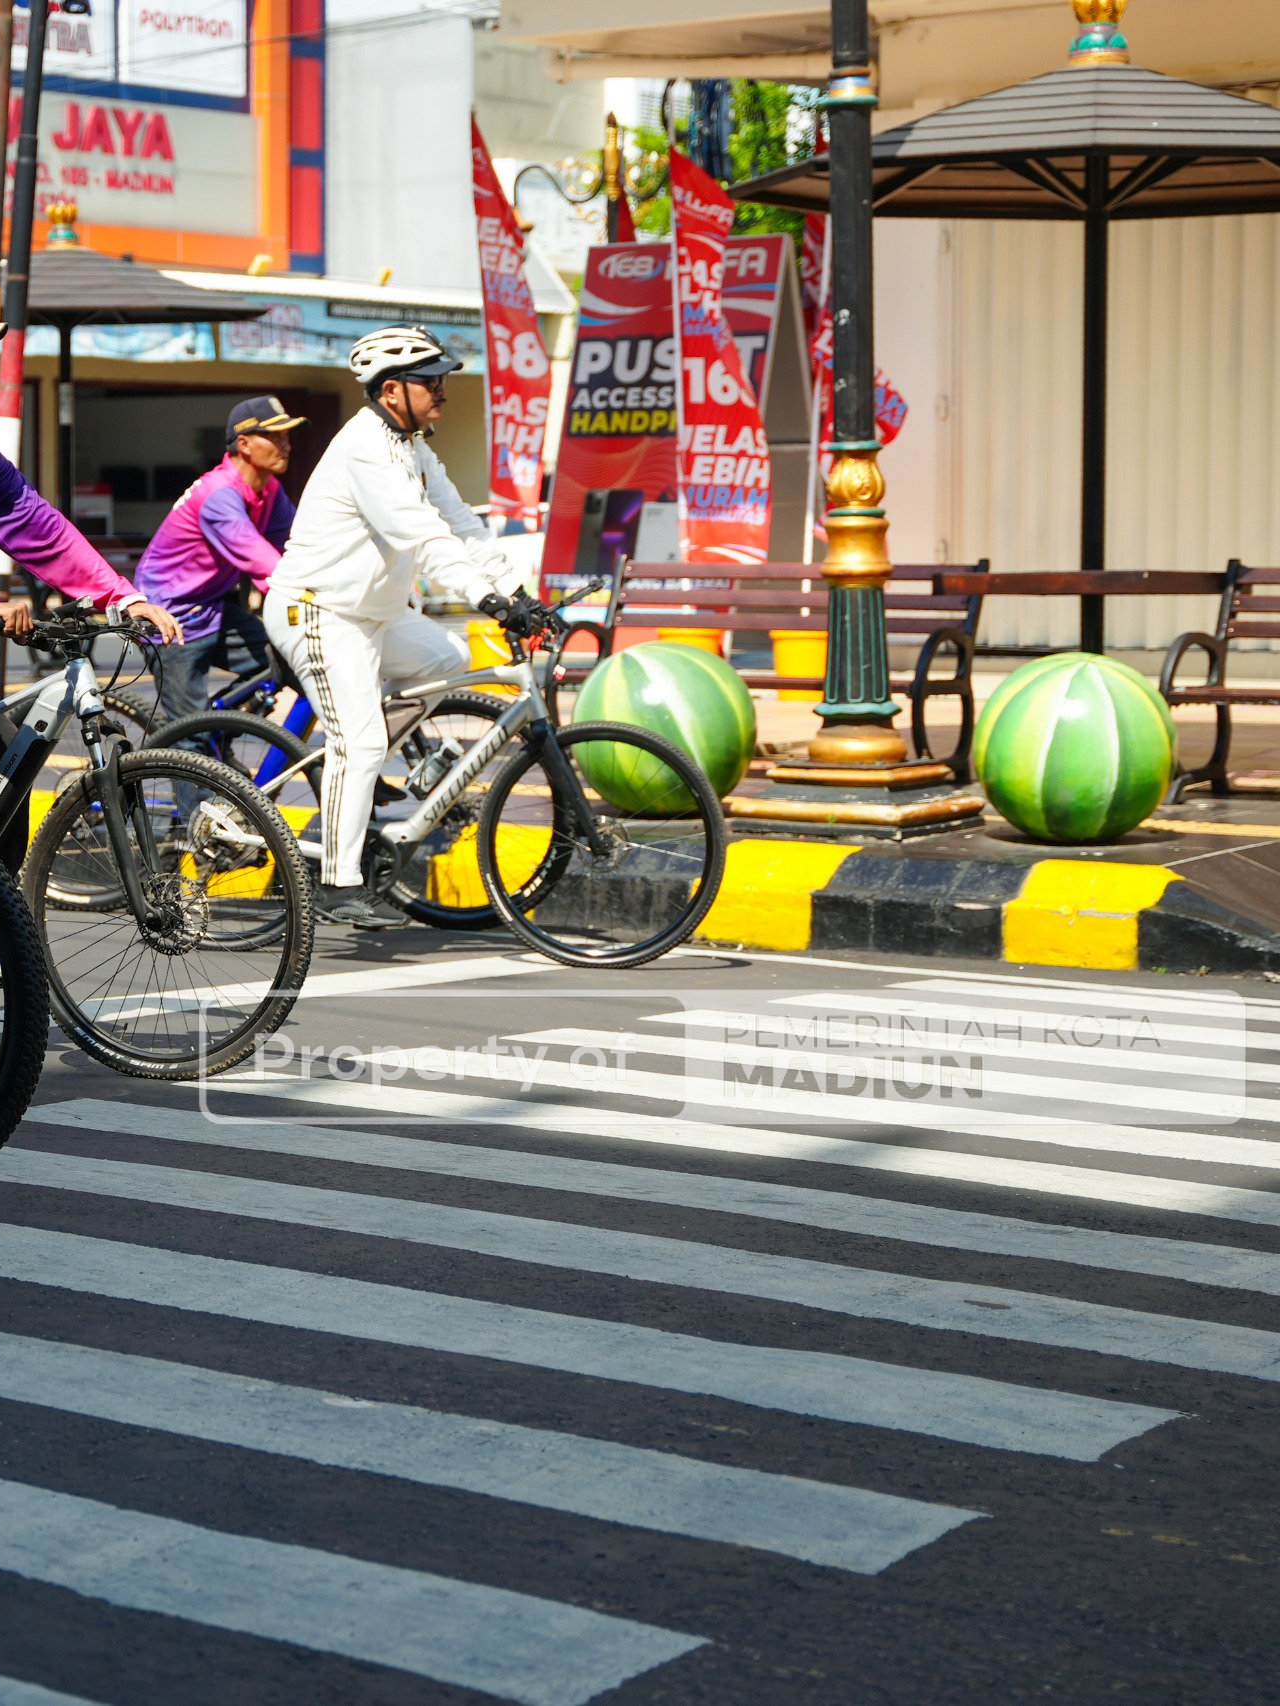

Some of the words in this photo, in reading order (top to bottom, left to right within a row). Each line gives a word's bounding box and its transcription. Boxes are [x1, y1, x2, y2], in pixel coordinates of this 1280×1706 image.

[52, 101, 174, 161] JAYA
[105, 168, 175, 195] MADIUN
[574, 335, 767, 385] PUST
[424, 725, 508, 824] SPECIALIZED
